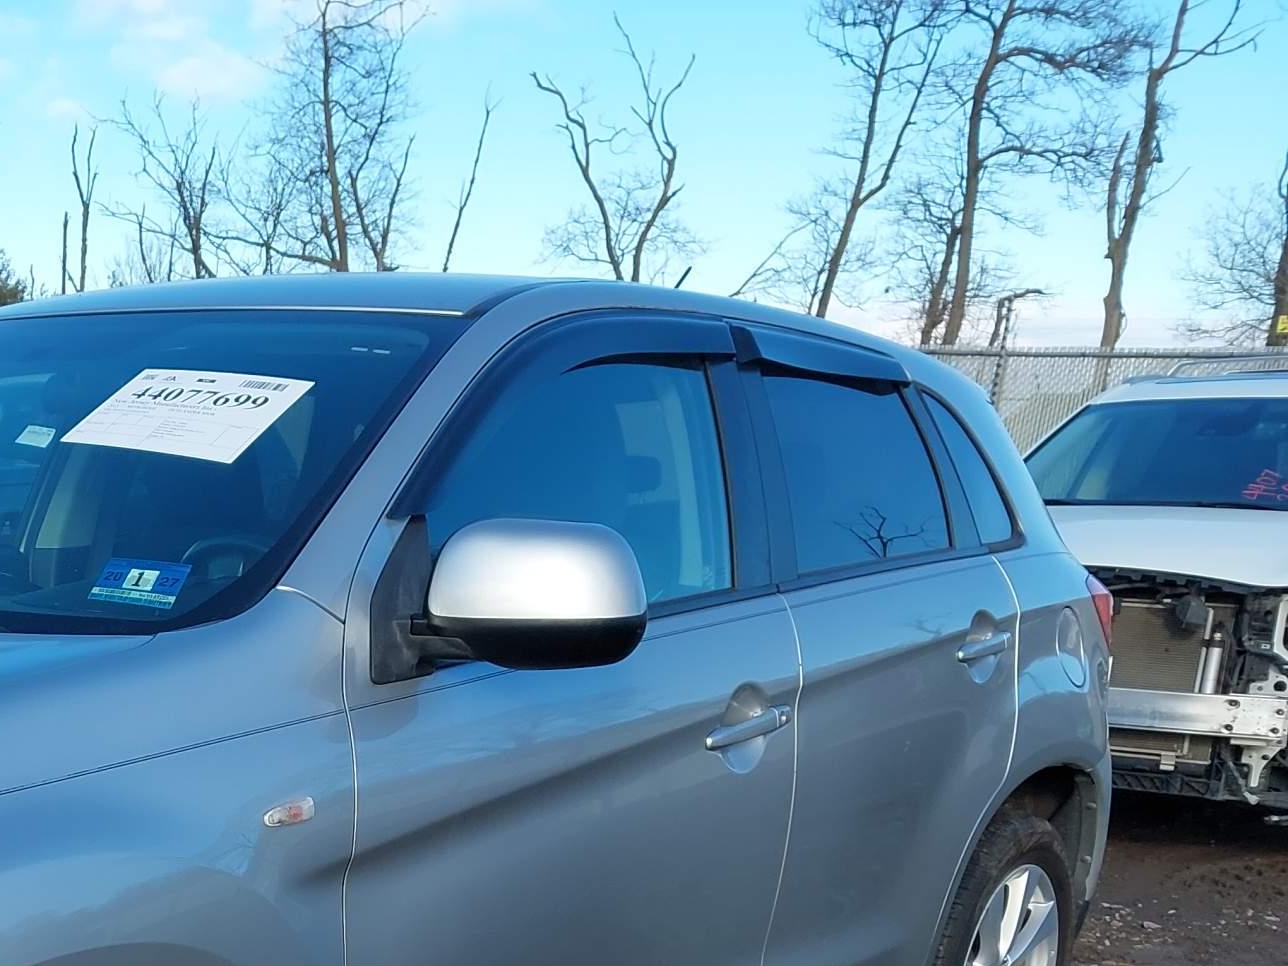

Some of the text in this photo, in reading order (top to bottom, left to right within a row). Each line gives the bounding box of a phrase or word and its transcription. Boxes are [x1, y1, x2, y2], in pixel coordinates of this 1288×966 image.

[131, 386, 270, 410] 44077699
[103, 570, 180, 587] 20 1 27
